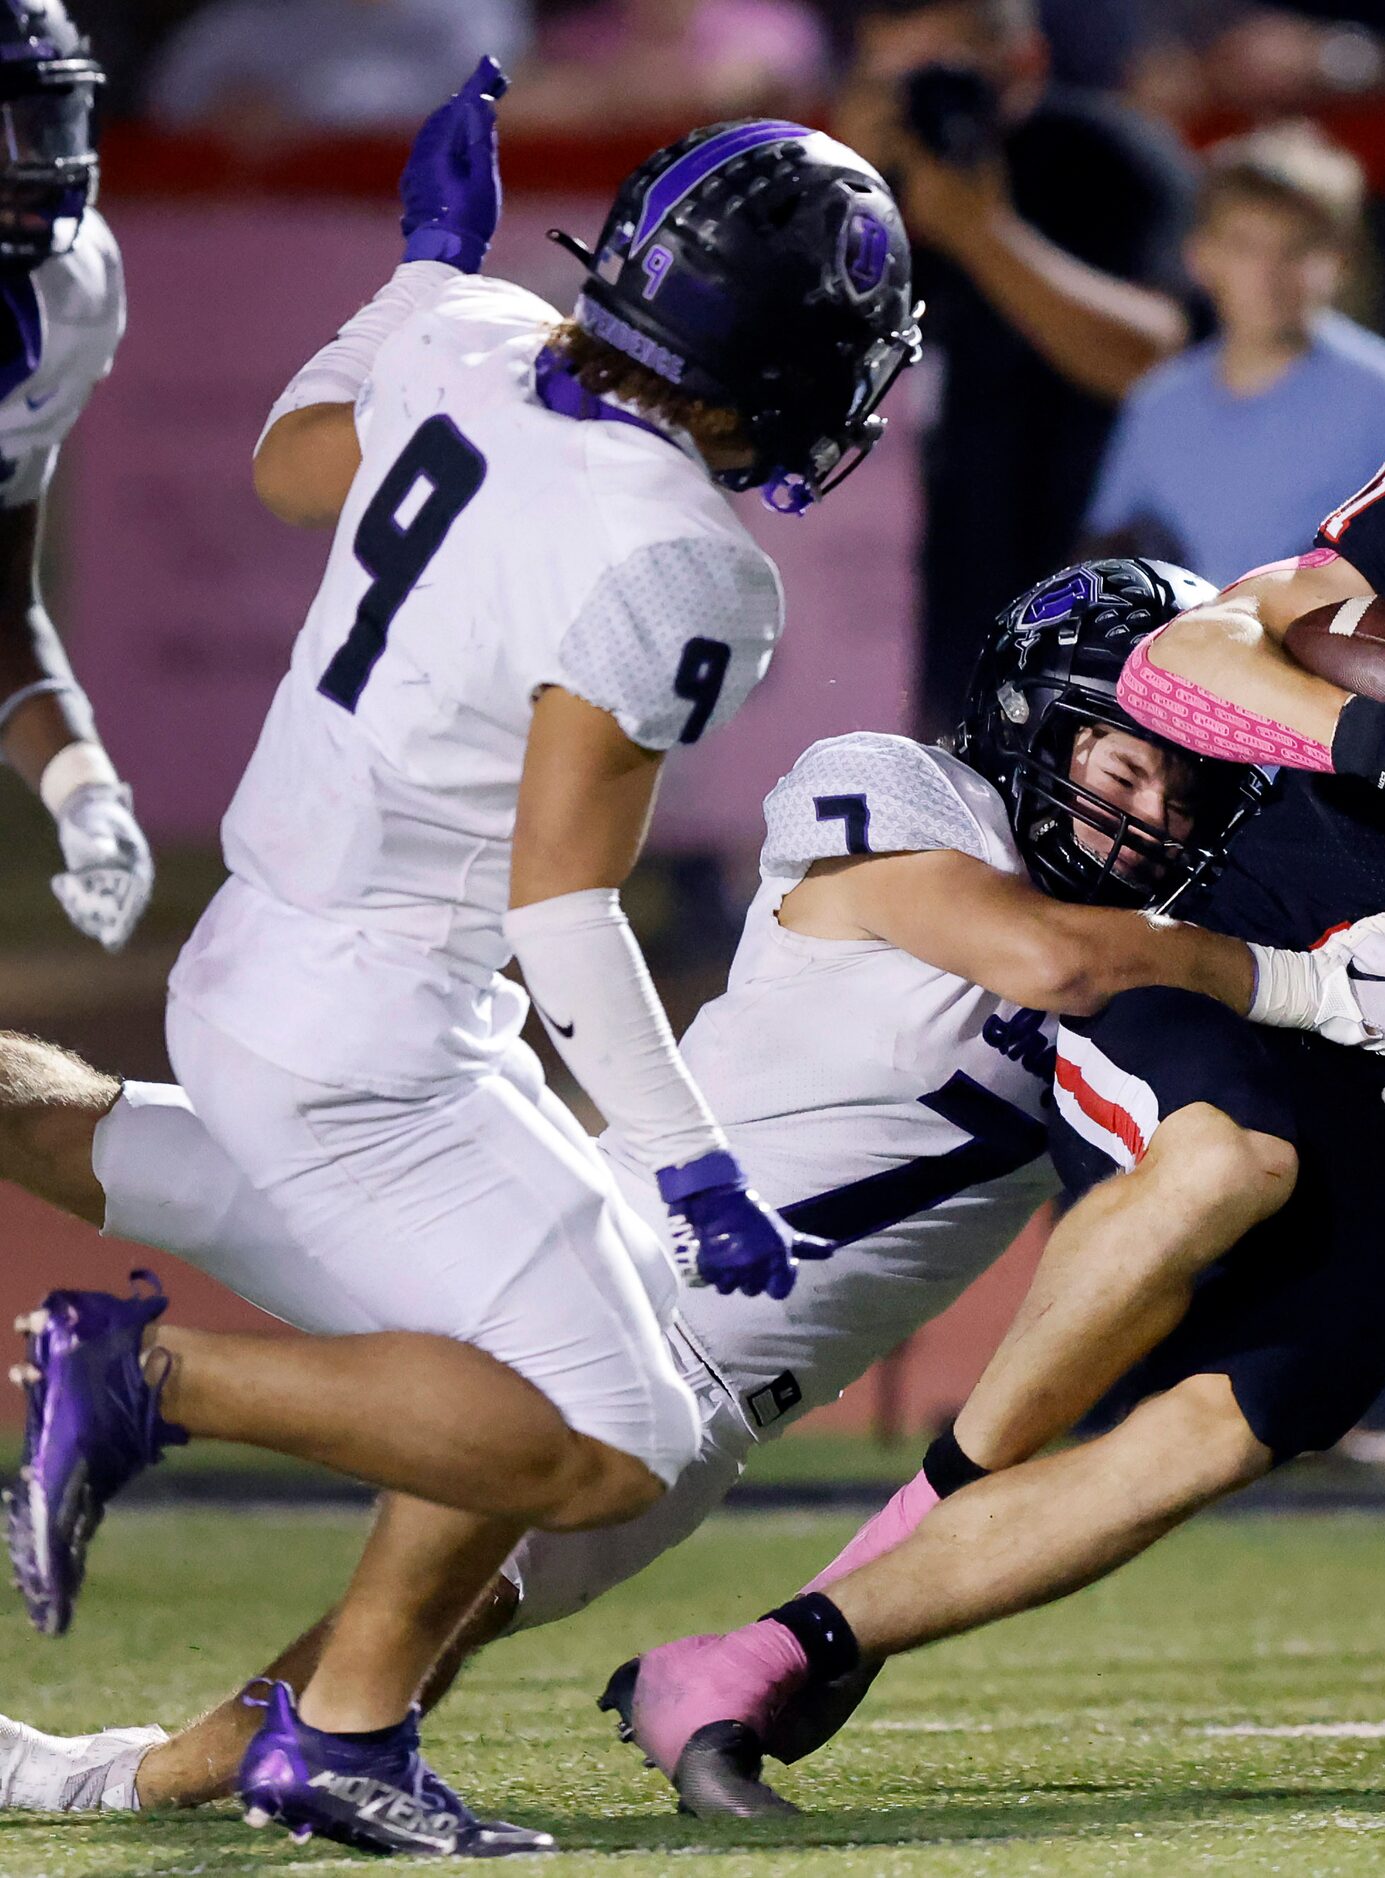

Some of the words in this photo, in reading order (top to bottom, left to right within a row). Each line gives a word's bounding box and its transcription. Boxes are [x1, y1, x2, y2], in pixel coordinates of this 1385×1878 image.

[641, 244, 674, 301] 9
[317, 413, 487, 714] 9
[674, 636, 732, 745] 9
[813, 793, 873, 855] 7
[776, 1069, 1050, 1249] 7
